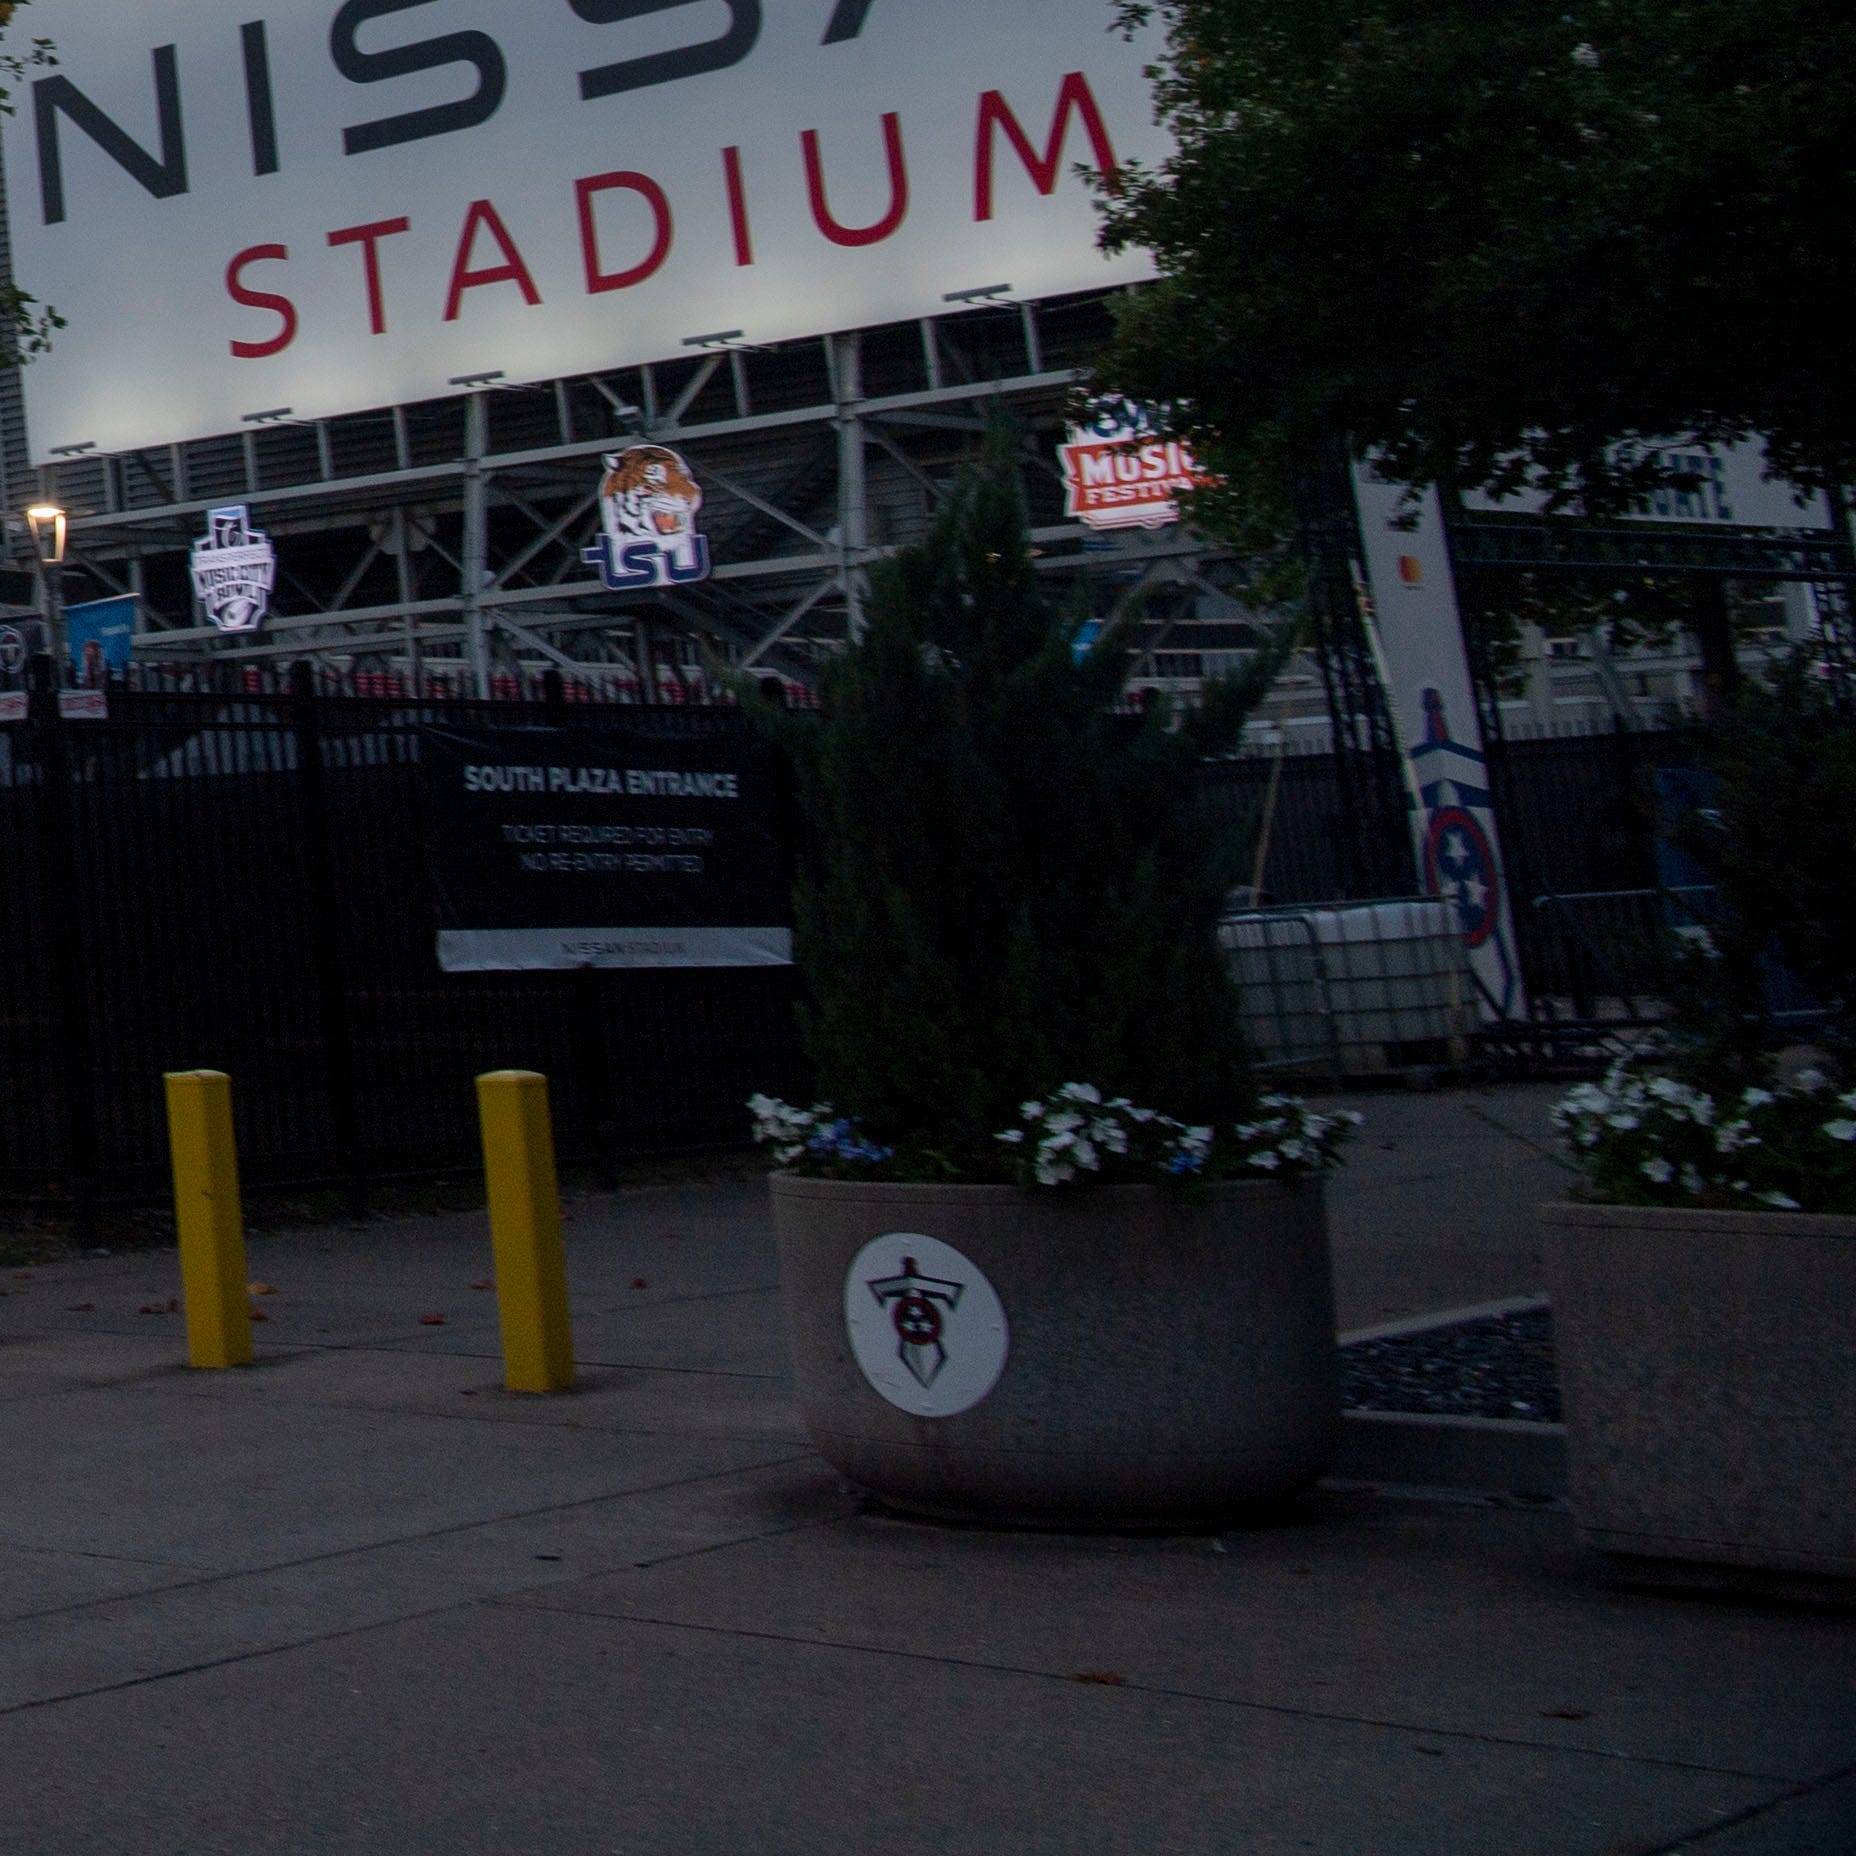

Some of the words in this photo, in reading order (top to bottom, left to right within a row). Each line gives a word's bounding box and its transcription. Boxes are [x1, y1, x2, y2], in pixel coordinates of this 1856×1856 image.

[224, 70, 1122, 359] STADIUM
[463, 765, 545, 792] SOUTH
[547, 767, 624, 794] PLAZA
[626, 770, 739, 798] ENTRANCE
